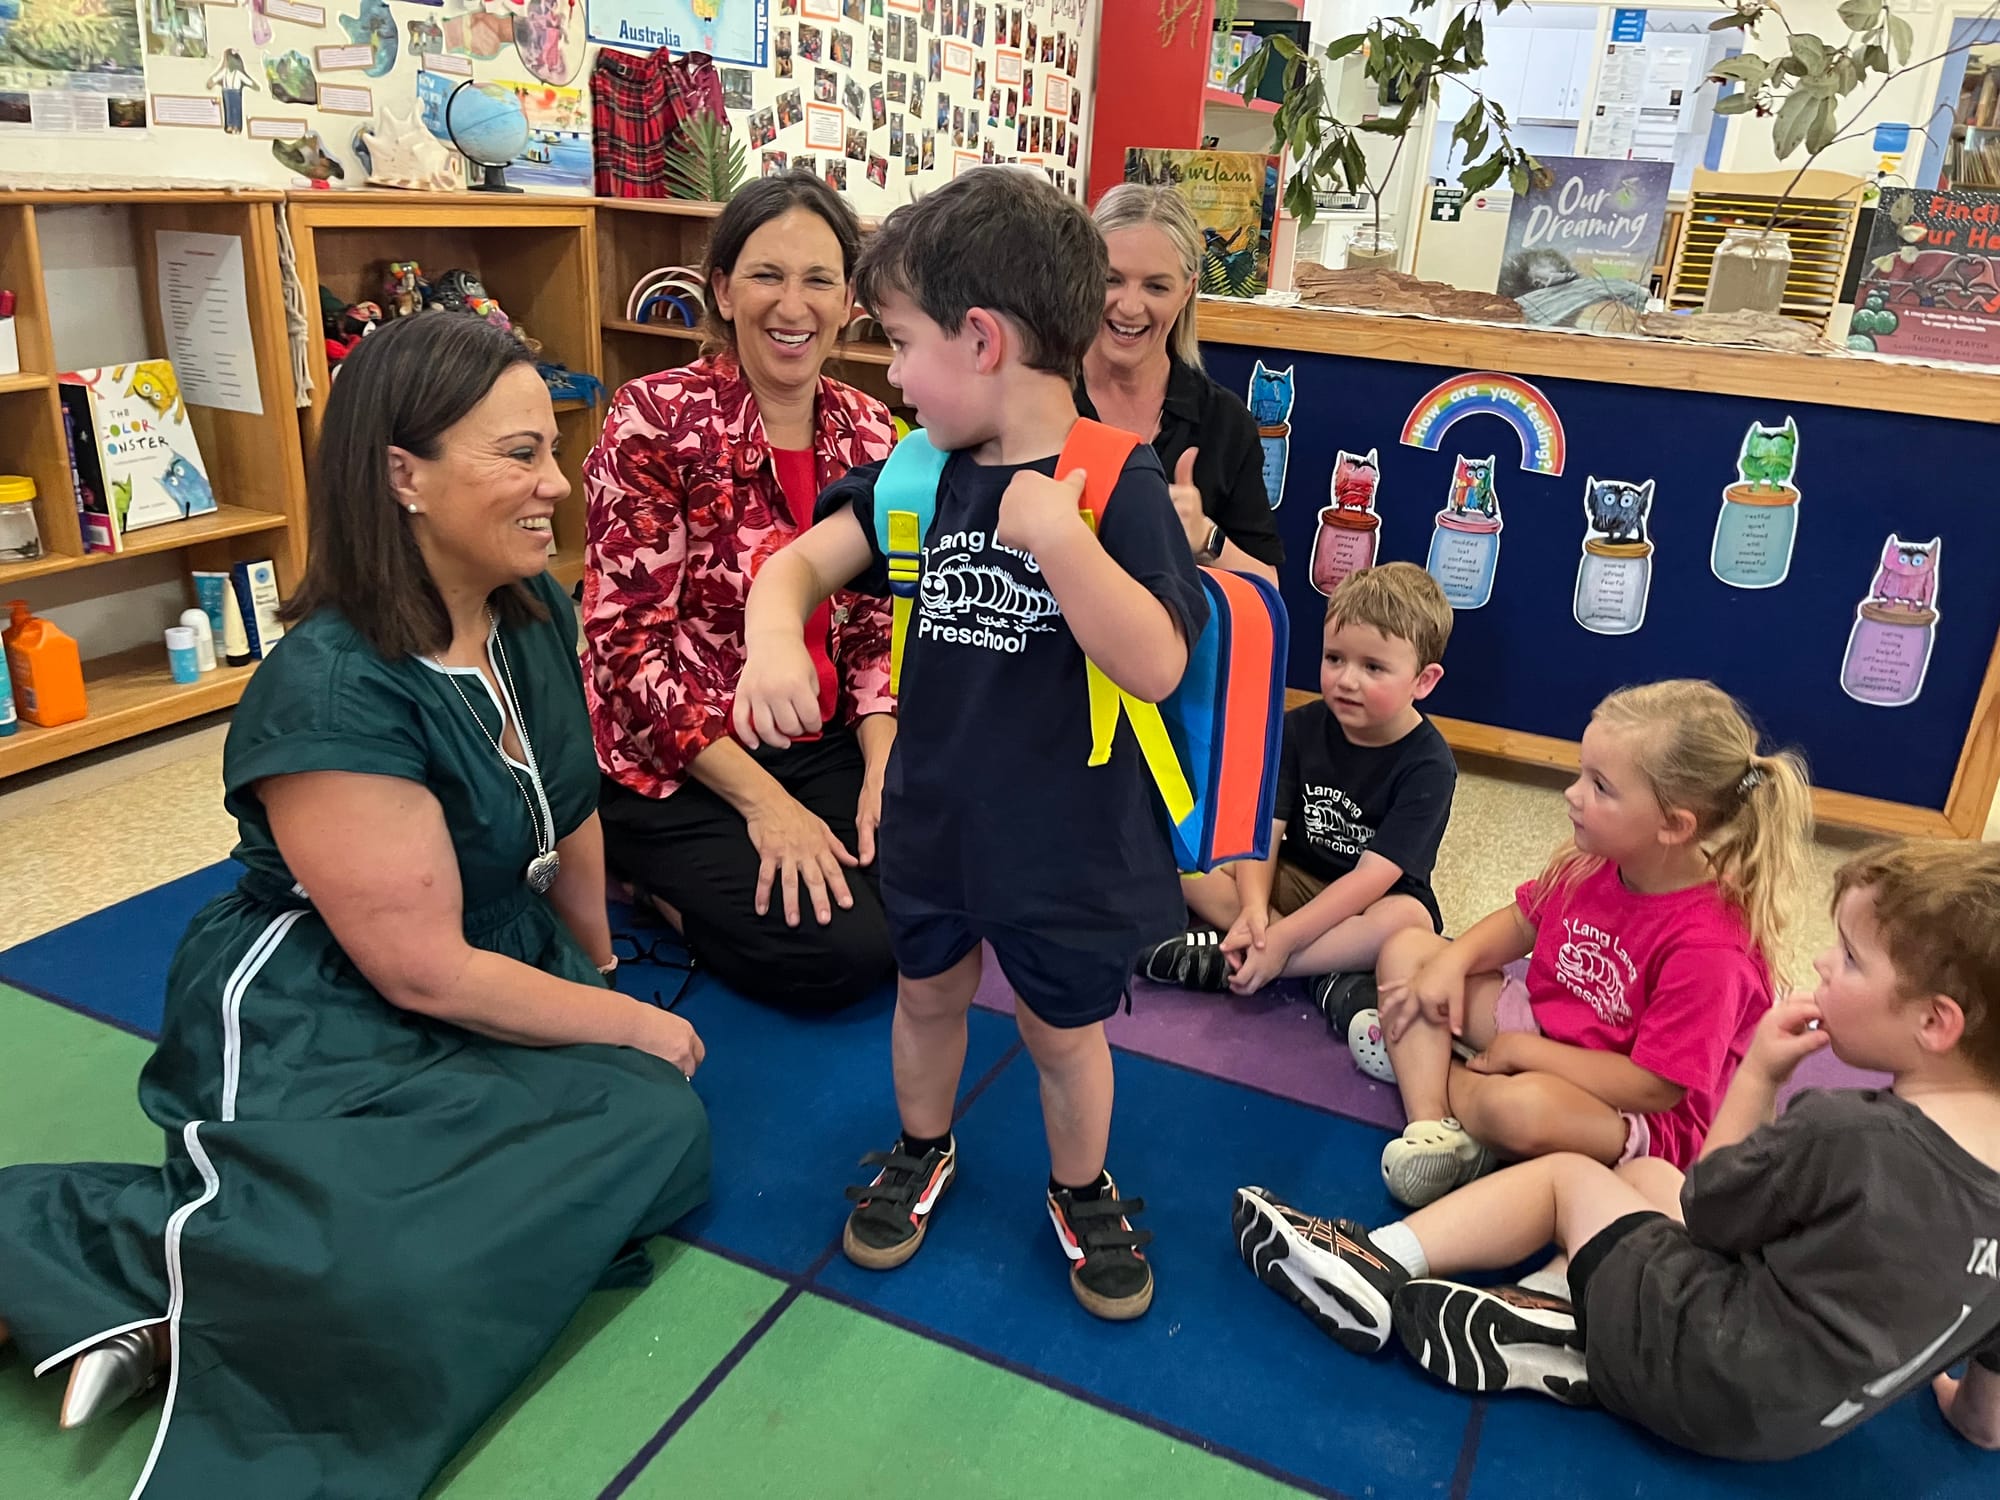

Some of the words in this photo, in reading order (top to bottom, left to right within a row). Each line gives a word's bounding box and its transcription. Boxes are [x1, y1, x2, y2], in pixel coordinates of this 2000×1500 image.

[618, 19, 681, 48] Australia
[1188, 161, 1253, 185] wilam
[1557, 176, 1612, 216] Our
[1521, 204, 1649, 249] Dreaming
[109, 408, 130, 418] THE
[1412, 405, 1441, 439] How
[1449, 385, 1479, 404] are
[1490, 386, 1522, 407] you
[1522, 402, 1554, 470] feeling?
[102, 419, 156, 440] OLOR
[107, 435, 169, 456] ONSTER
[918, 617, 1027, 653] Preschool
[1305, 783, 1342, 803] Lang
[1306, 830, 1363, 855] reschoo
[1572, 918, 1611, 948] Lang
[1966, 1237, 2000, 1280] TA
